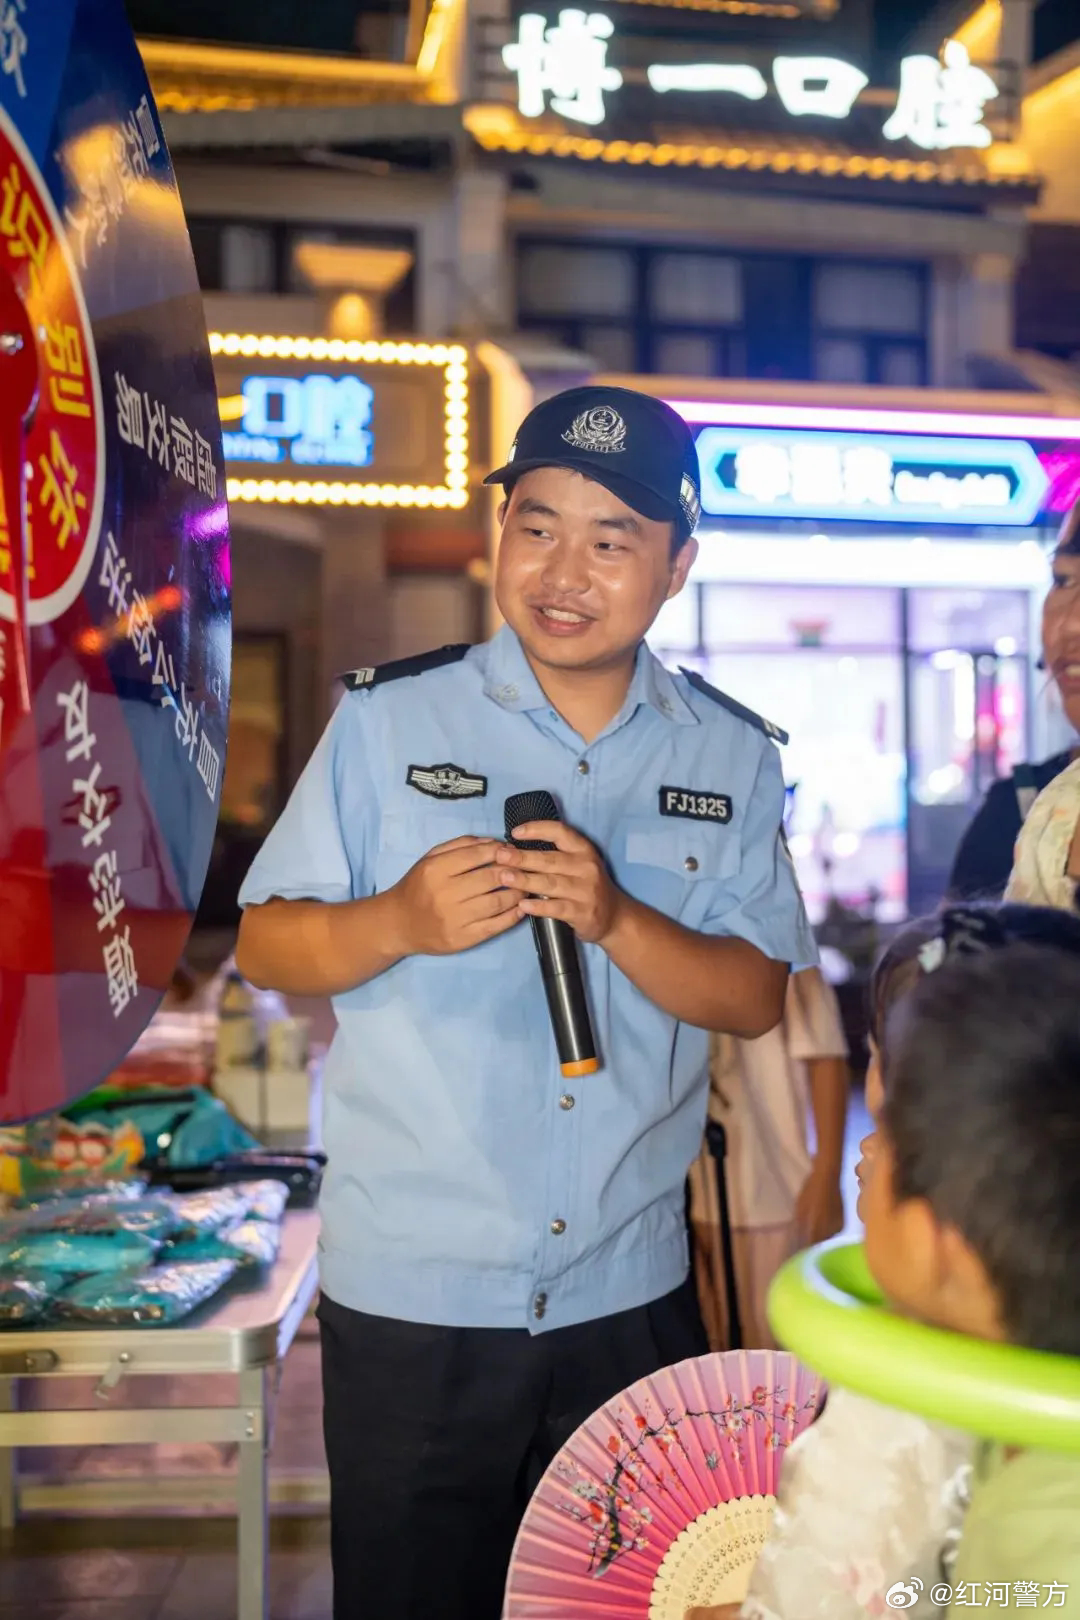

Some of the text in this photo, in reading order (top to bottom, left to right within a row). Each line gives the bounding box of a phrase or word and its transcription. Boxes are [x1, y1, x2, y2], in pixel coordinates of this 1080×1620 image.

[114, 370, 218, 500] 虚假交易
[98, 531, 220, 803] 冒充公检法
[57, 680, 138, 1018] 婚恋交友
[665, 791, 727, 818] FJ1325
